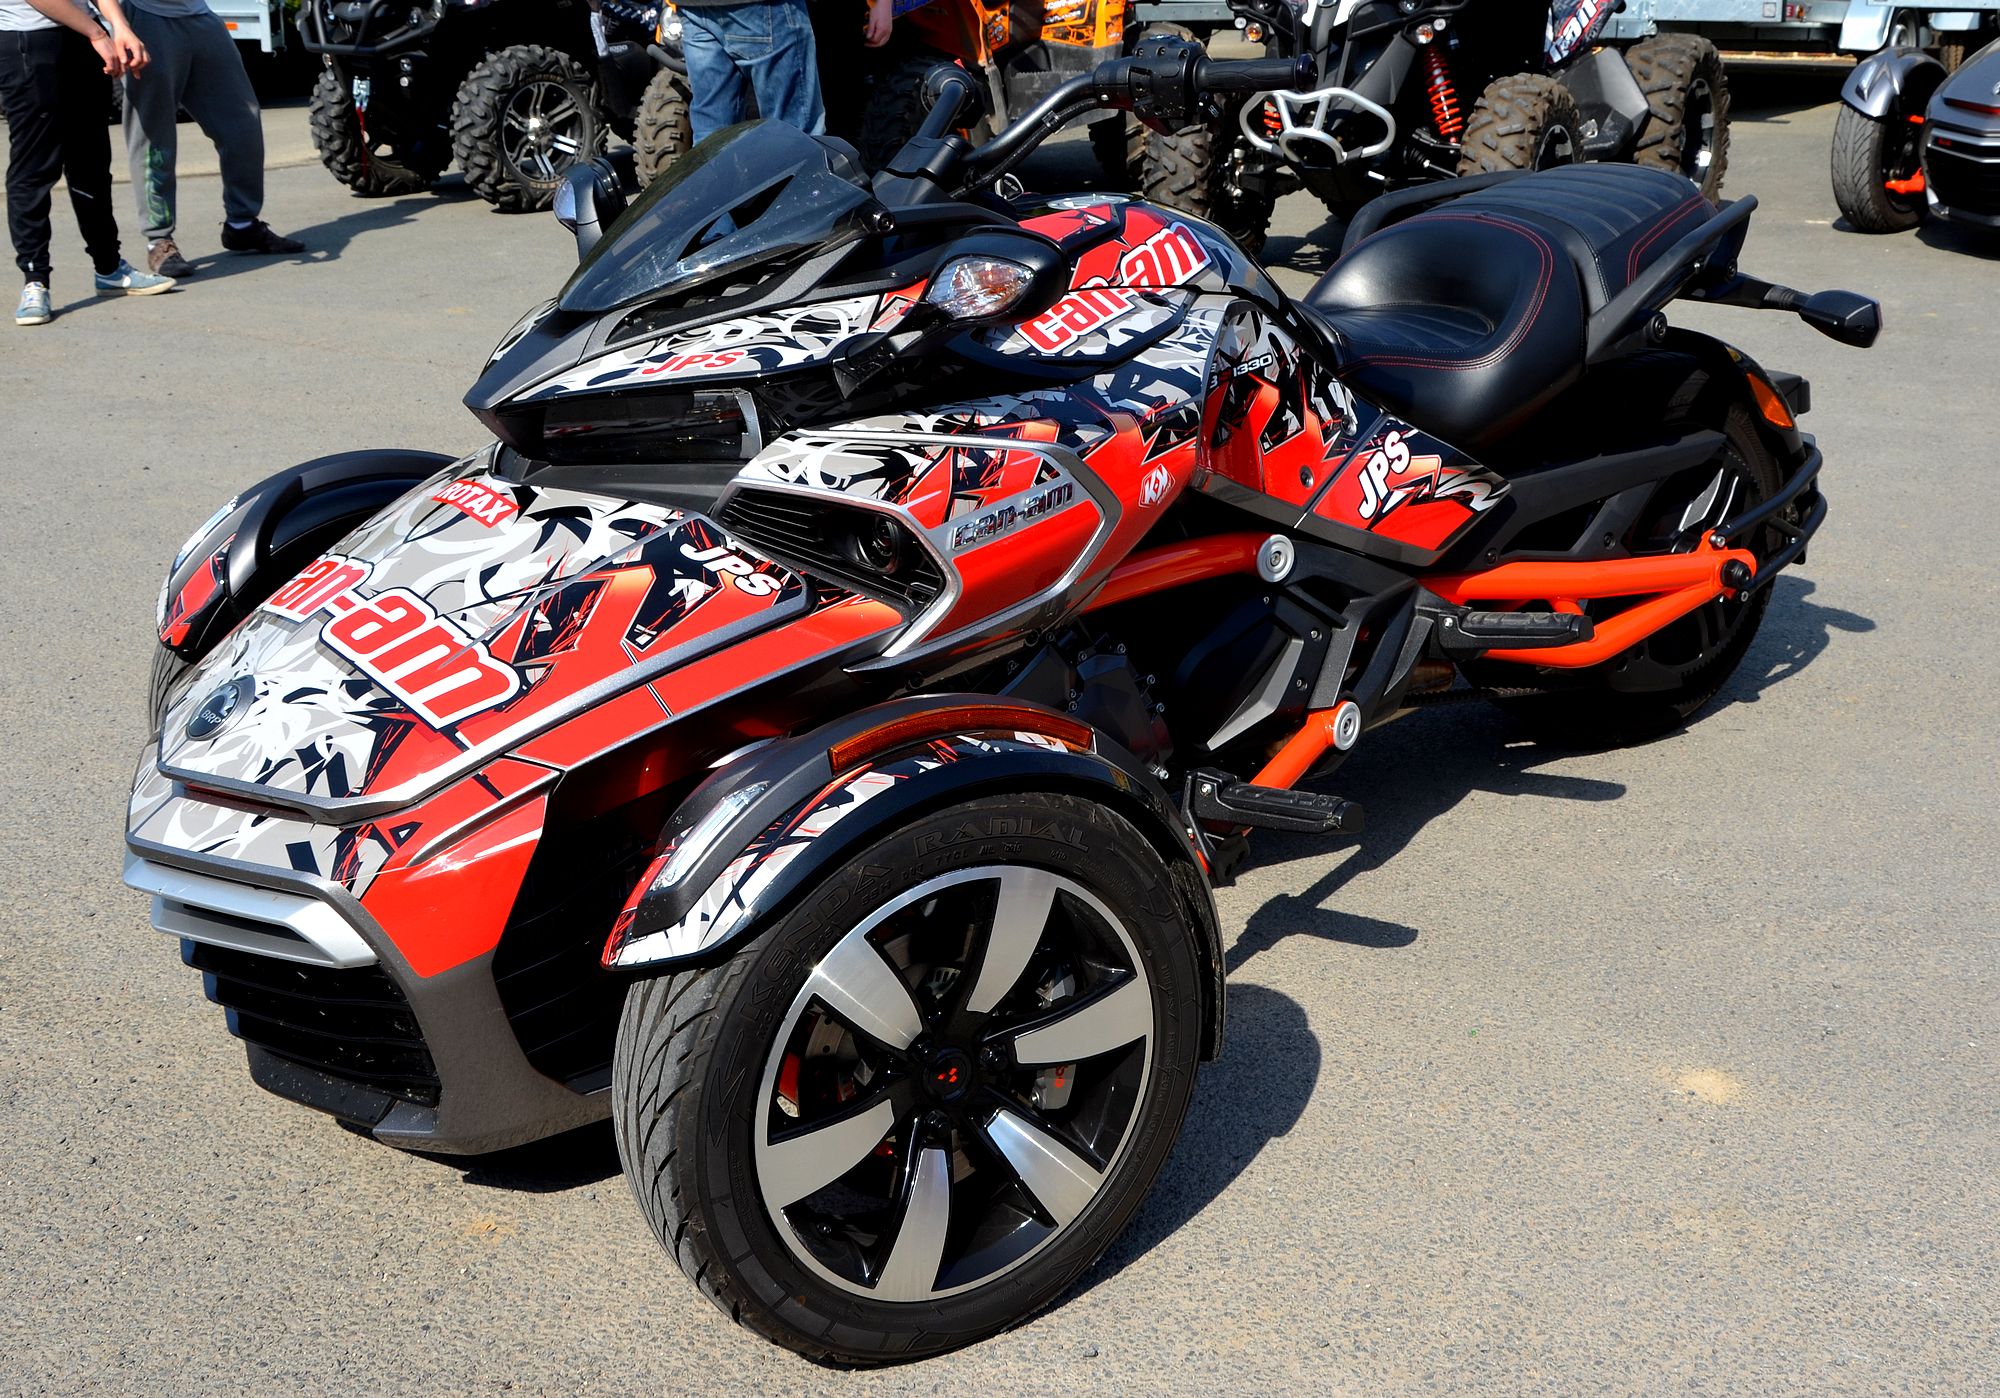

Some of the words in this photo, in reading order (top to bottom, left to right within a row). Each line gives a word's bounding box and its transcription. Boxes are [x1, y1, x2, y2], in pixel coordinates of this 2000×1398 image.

[1018, 224, 1208, 350] can-am
[641, 351, 745, 375] JPS
[1233, 353, 1273, 378] 1330
[1358, 430, 1411, 519] JPS
[436, 482, 513, 524] ROTAX
[952, 481, 1073, 550] can-am
[679, 543, 783, 597] JPS
[201, 709, 222, 724] BRP
[739, 864, 894, 1024] KENDA
[913, 816, 1090, 859] RADIAL
